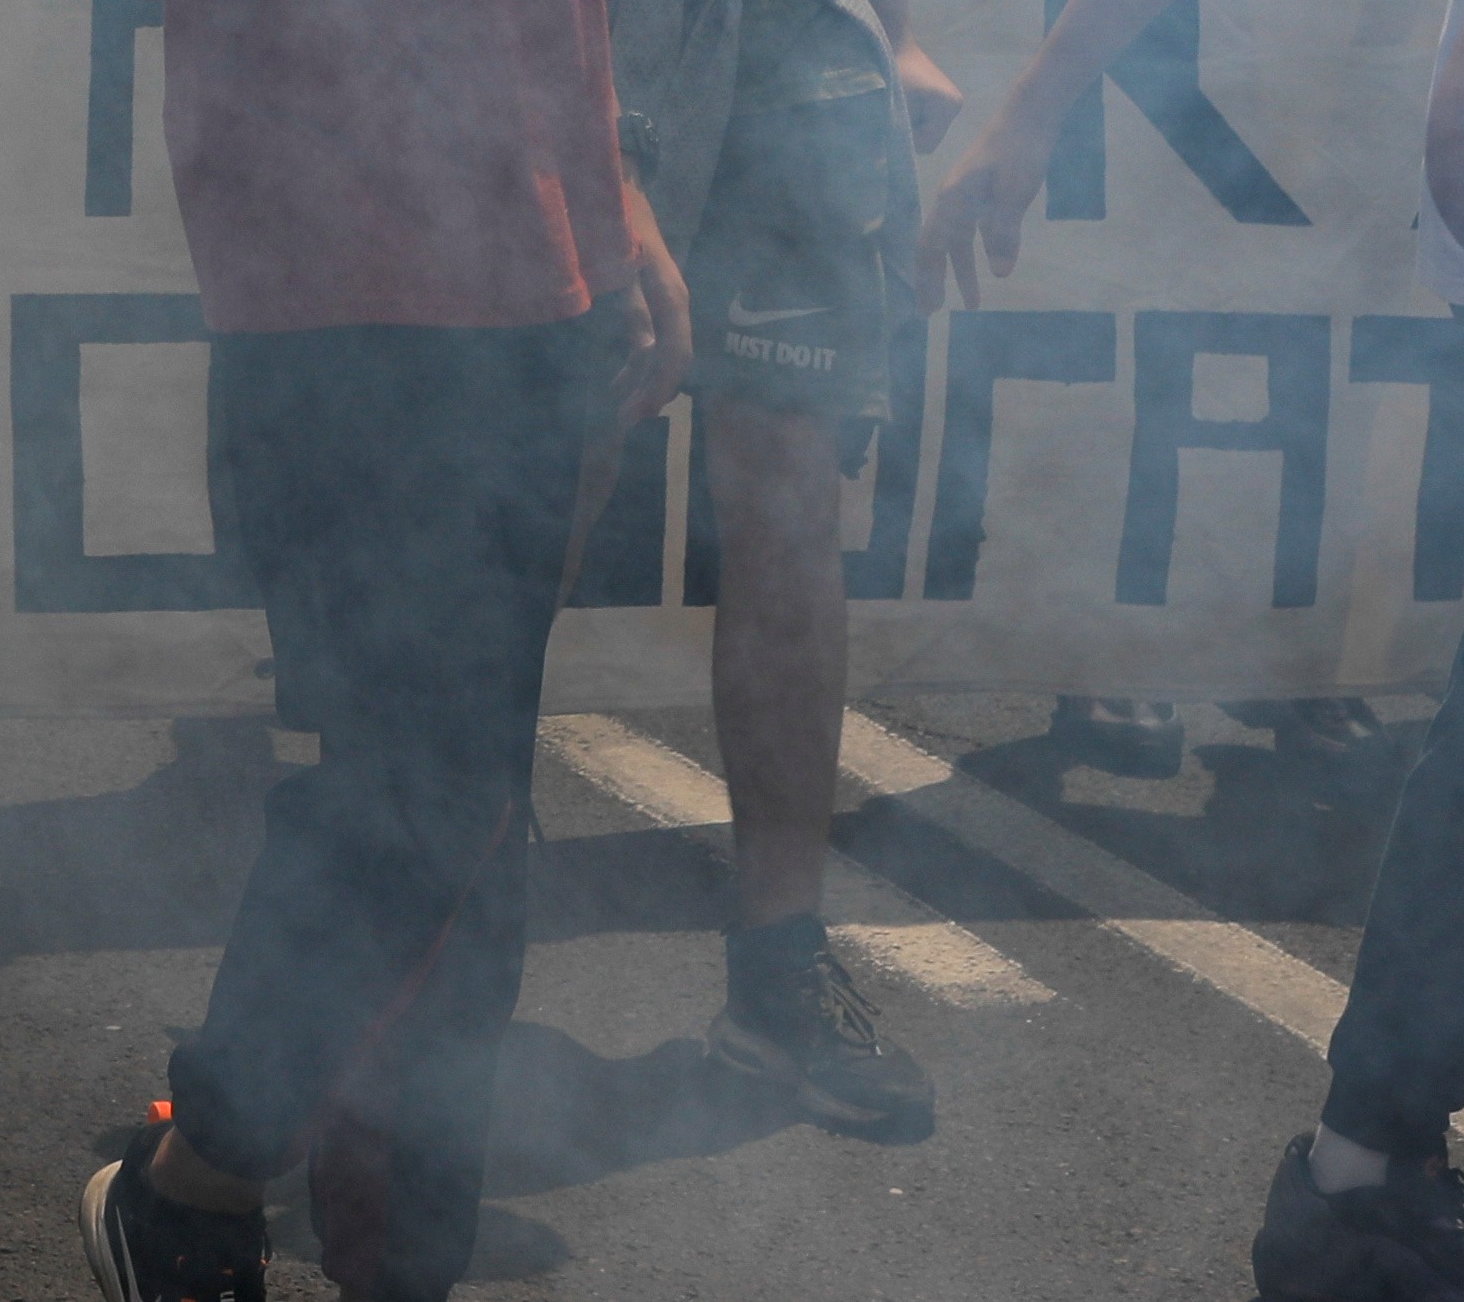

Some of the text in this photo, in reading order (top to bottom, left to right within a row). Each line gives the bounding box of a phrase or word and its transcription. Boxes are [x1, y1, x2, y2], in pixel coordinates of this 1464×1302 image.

[725, 331, 837, 372] JUST DO IT
